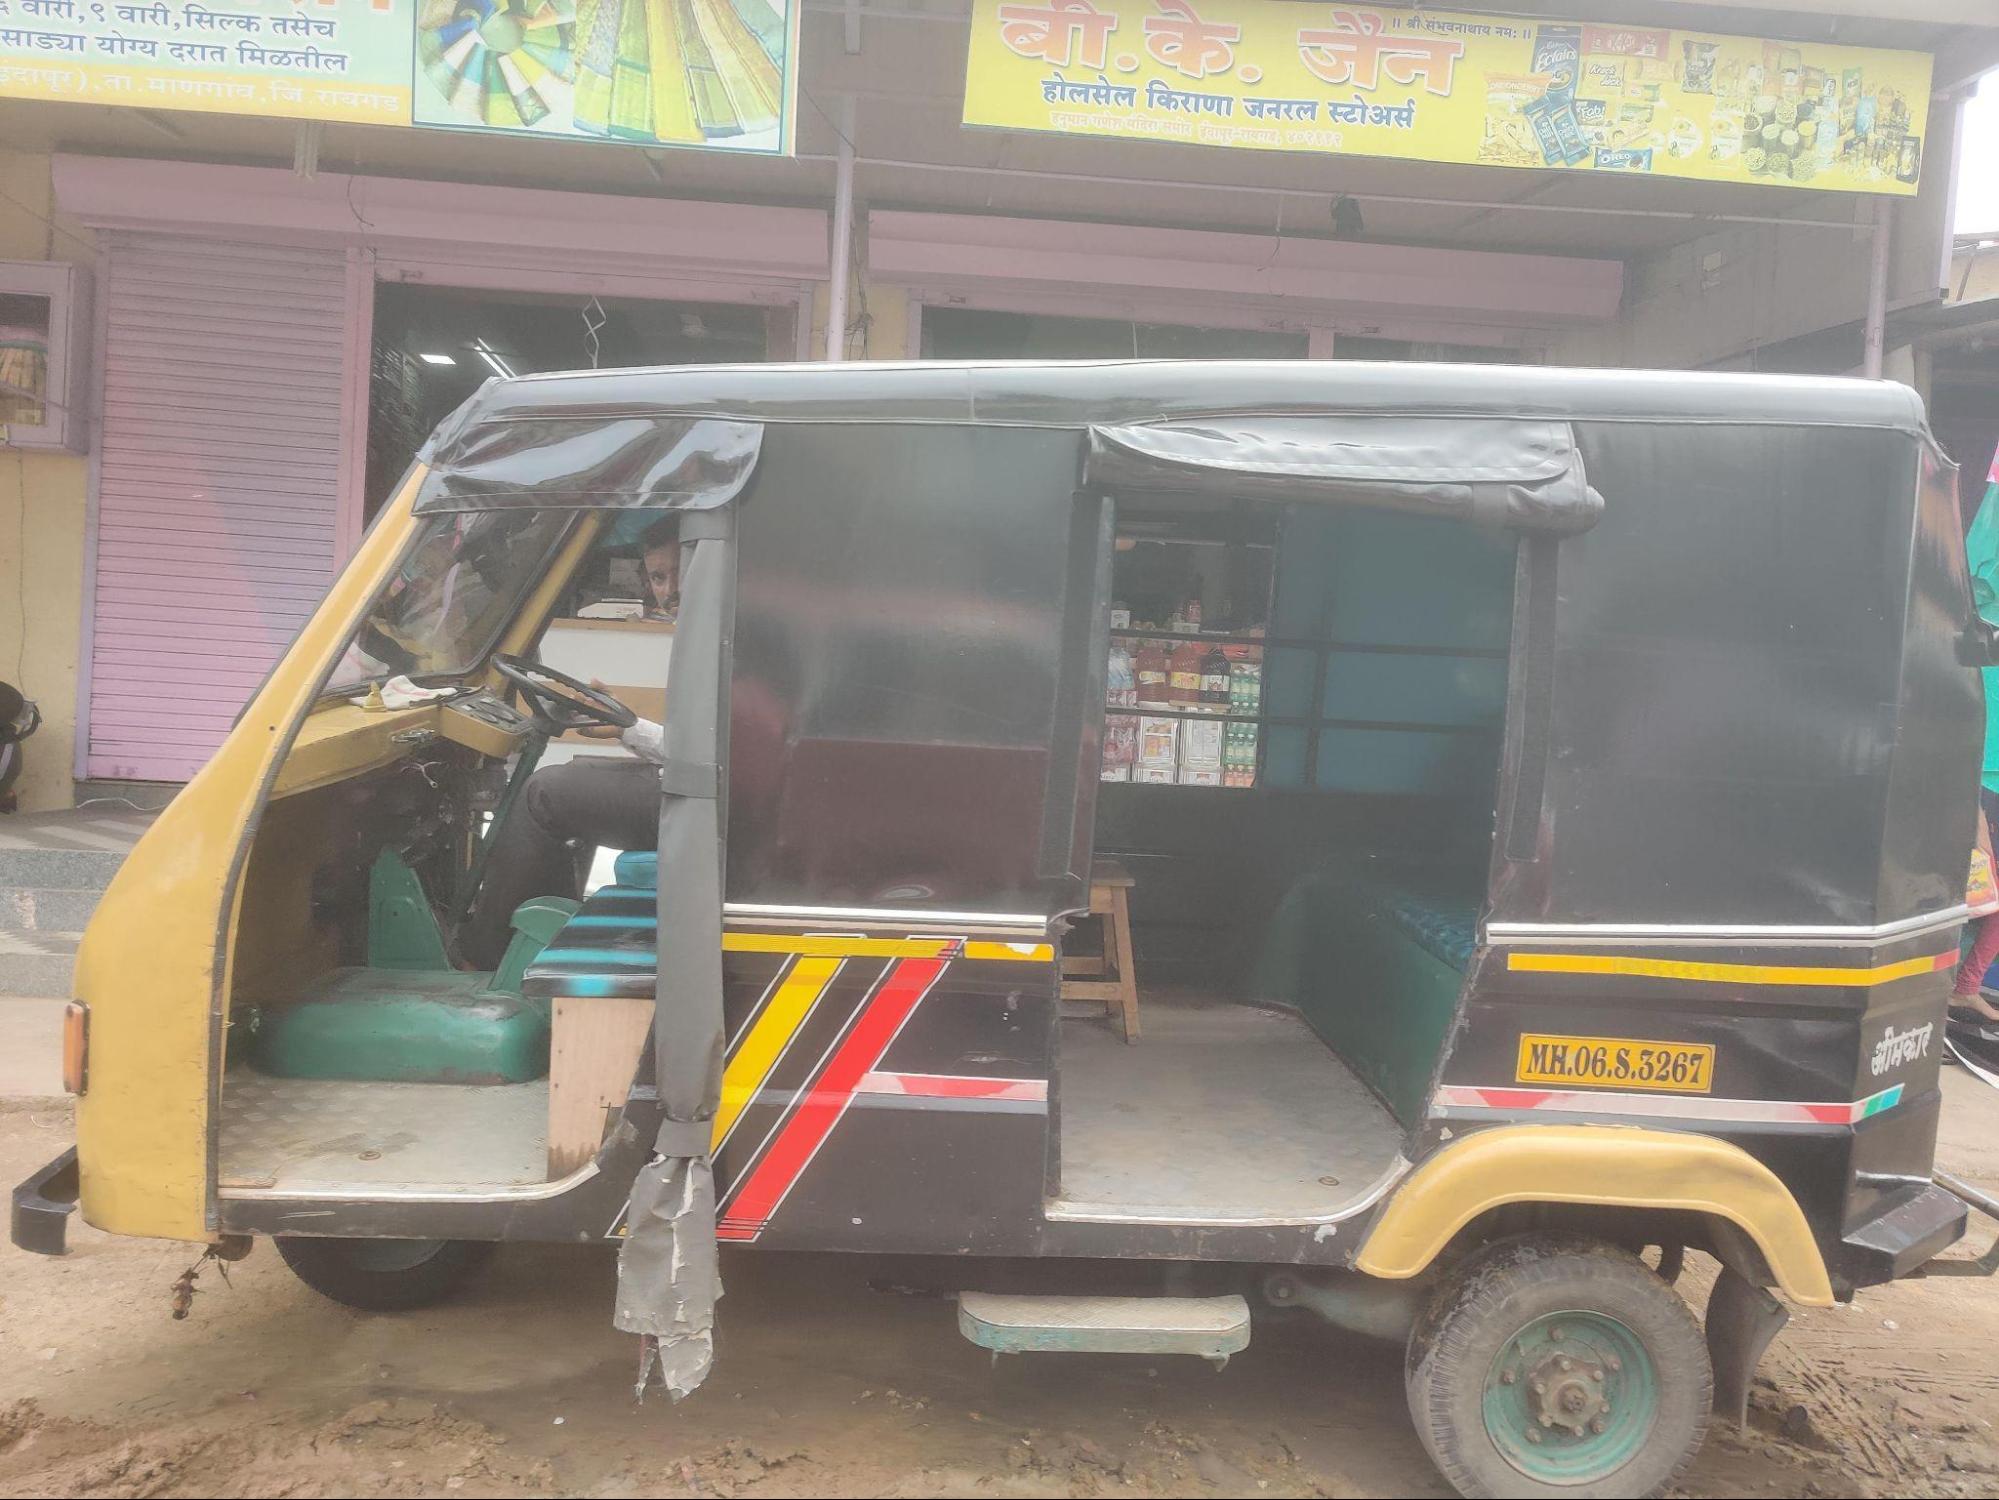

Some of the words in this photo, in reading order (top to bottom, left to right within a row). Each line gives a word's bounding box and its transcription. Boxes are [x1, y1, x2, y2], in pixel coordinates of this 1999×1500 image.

[270, 11, 336, 38] तसेच
[1406, 15, 1421, 30] श्री
[0, 29, 87, 53] साड्या
[95, 30, 158, 57] योग्य
[166, 42, 227, 63] दरात
[236, 40, 349, 71] मिळतील
[1298, 9, 1465, 97] जैन
[1041, 71, 1137, 107] होलसेल
[1146, 79, 1234, 117] किराणा
[1243, 97, 1319, 122] जनरल
[1327, 94, 1416, 128] स्टोअर्स
[1600, 152, 1632, 164] OREO
[1526, 1042, 1705, 1085] MH.06.S.3267
